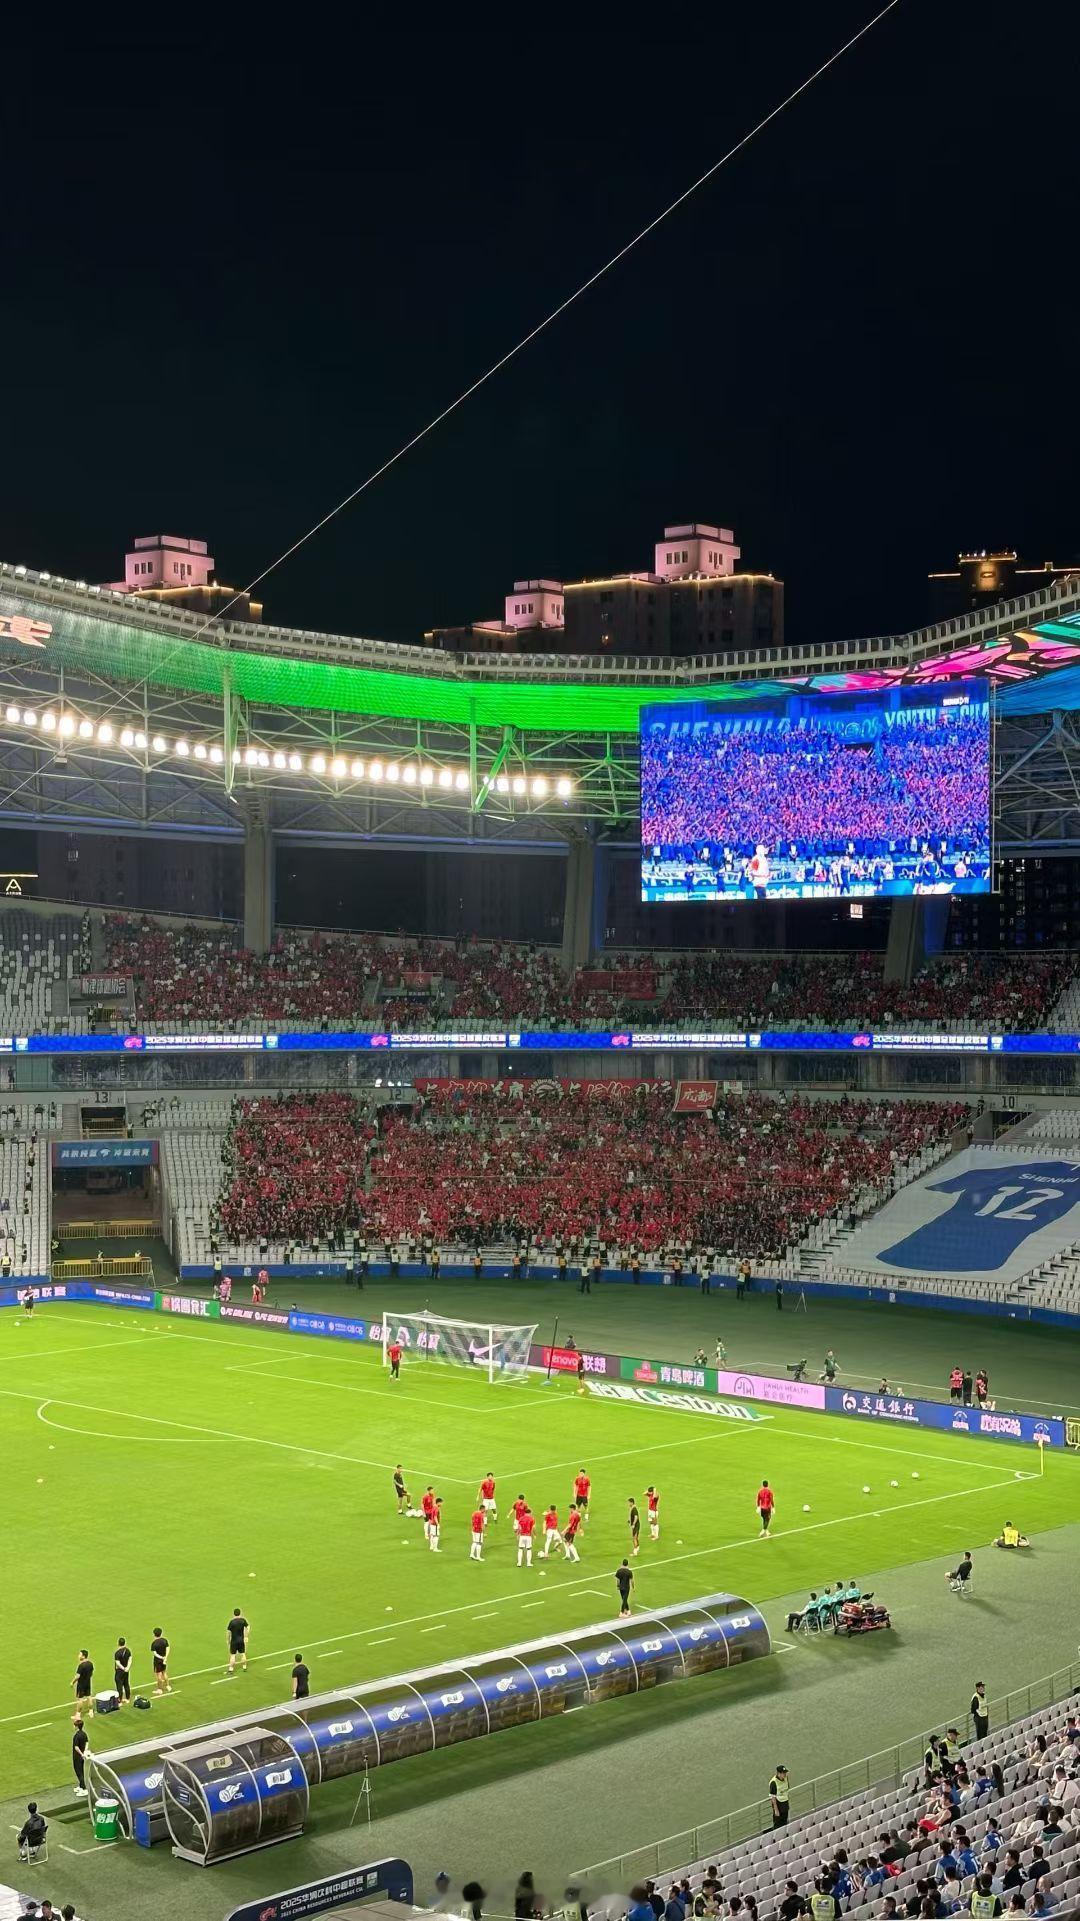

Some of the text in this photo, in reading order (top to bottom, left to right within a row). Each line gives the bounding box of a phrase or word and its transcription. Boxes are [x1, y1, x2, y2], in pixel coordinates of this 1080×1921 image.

[94, 1091, 109, 1103] 13
[999, 1095, 1016, 1109] 10
[974, 1186, 1065, 1221] 12
[546, 1351, 578, 1366] Lenovo
[582, 1354, 607, 1374] 联想
[660, 1366, 705, 1387] 青岛啤酒
[233, 1792, 245, 1800] CSL
[280, 1875, 364, 1910] 2025华润饮料中超联赛
[292, 1906, 306, 1914] CHINA
[307, 1897, 332, 1909] RESOURCES
[333, 1889, 355, 1902] BEVERAGE
